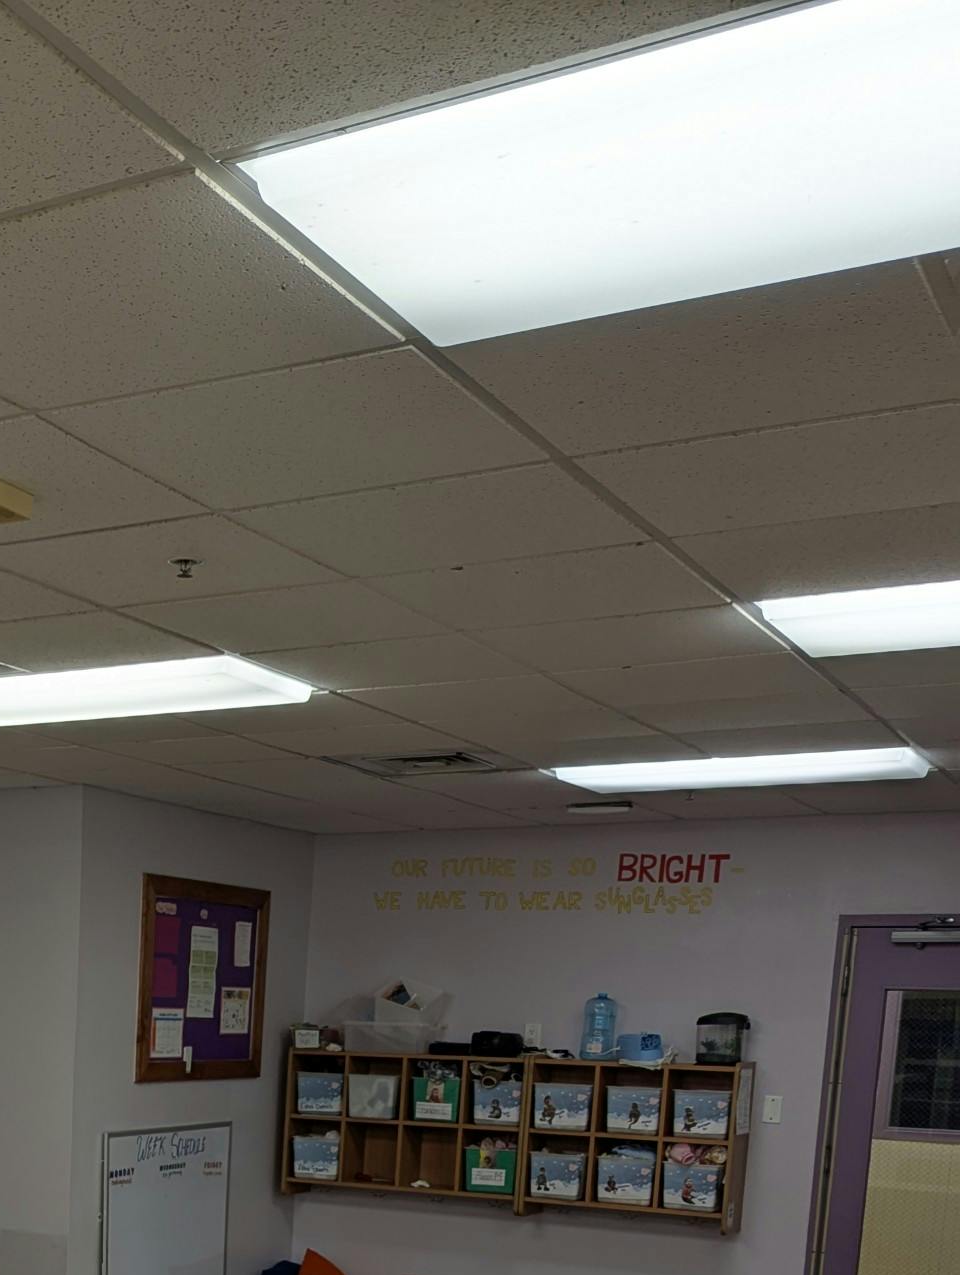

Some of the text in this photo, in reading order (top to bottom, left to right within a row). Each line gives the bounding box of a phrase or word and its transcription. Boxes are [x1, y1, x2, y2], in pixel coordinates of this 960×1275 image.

[391, 858, 429, 878] OUR
[442, 858, 517, 878] FUTURE
[533, 858, 552, 878] IS
[568, 857, 597, 876] SO
[374, 886, 713, 914] WE HAVE TO WEAR SUNGLASSES
